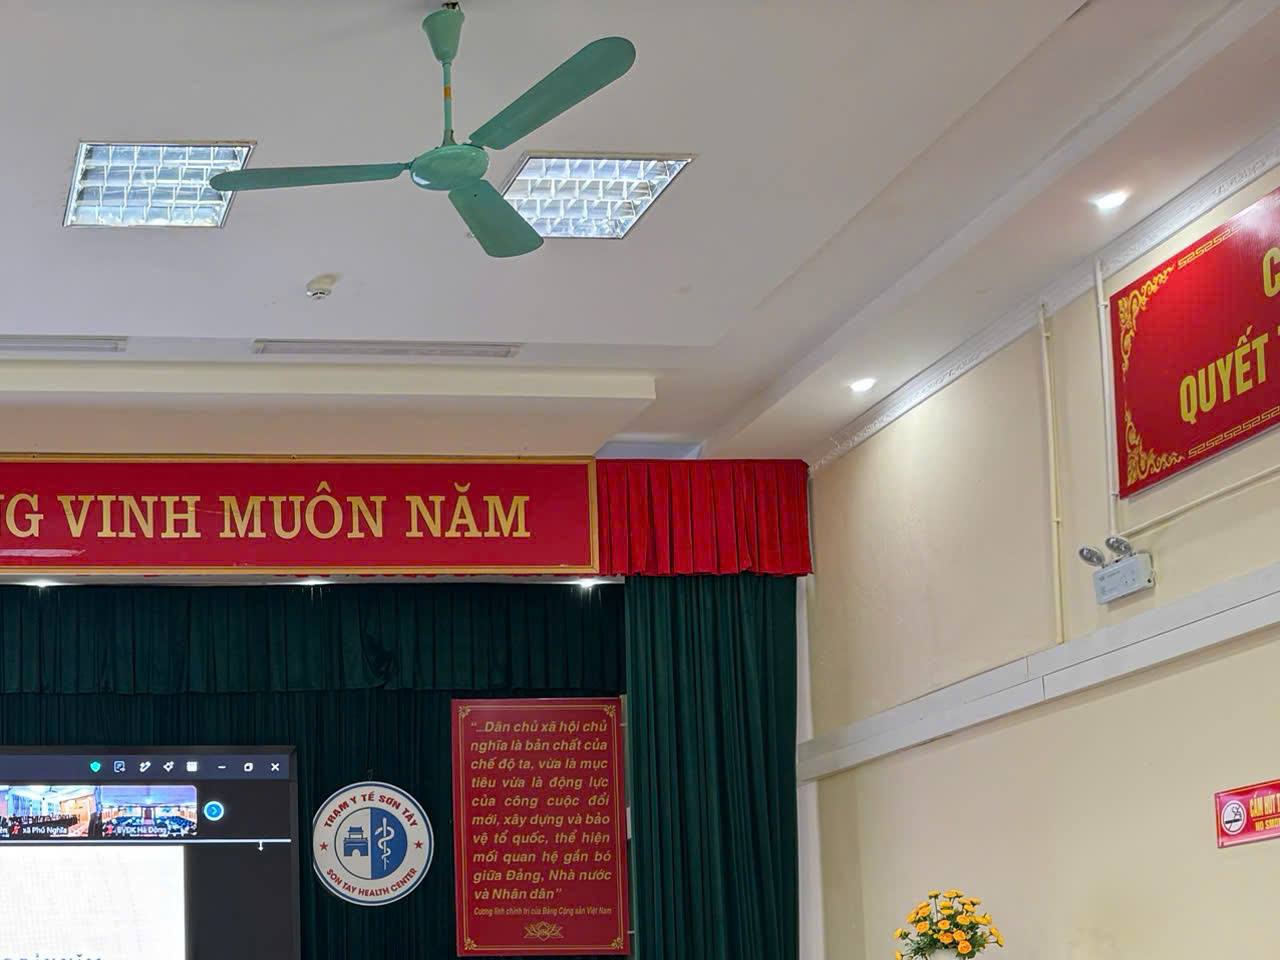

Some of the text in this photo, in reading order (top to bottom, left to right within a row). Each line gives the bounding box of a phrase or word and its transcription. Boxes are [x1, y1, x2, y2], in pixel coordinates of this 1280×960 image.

[1180, 325, 1268, 424] QUYẾT
[58, 495, 201, 539] VINH
[219, 481, 385, 540] MUÔN
[406, 482, 530, 538] NĂM
[514, 720, 607, 733] chủ xã hội chủ
[471, 738, 607, 753] nghĩa là chất của
[471, 757, 607, 771] chế độ là mục
[472, 777, 582, 789] tiêu là động
[472, 794, 579, 808] của công cuộc
[324, 791, 418, 828] TRẠM Y TẾ SƠN TÂY
[504, 813, 609, 827] xây và bảo
[473, 832, 609, 845] vệ hiện
[503, 851, 558, 864] quan hệ
[549, 869, 612, 880] Nhà nước
[327, 868, 417, 896] SON TAY HEALTH CENTER
[474, 888, 526, 899] và Nhân
